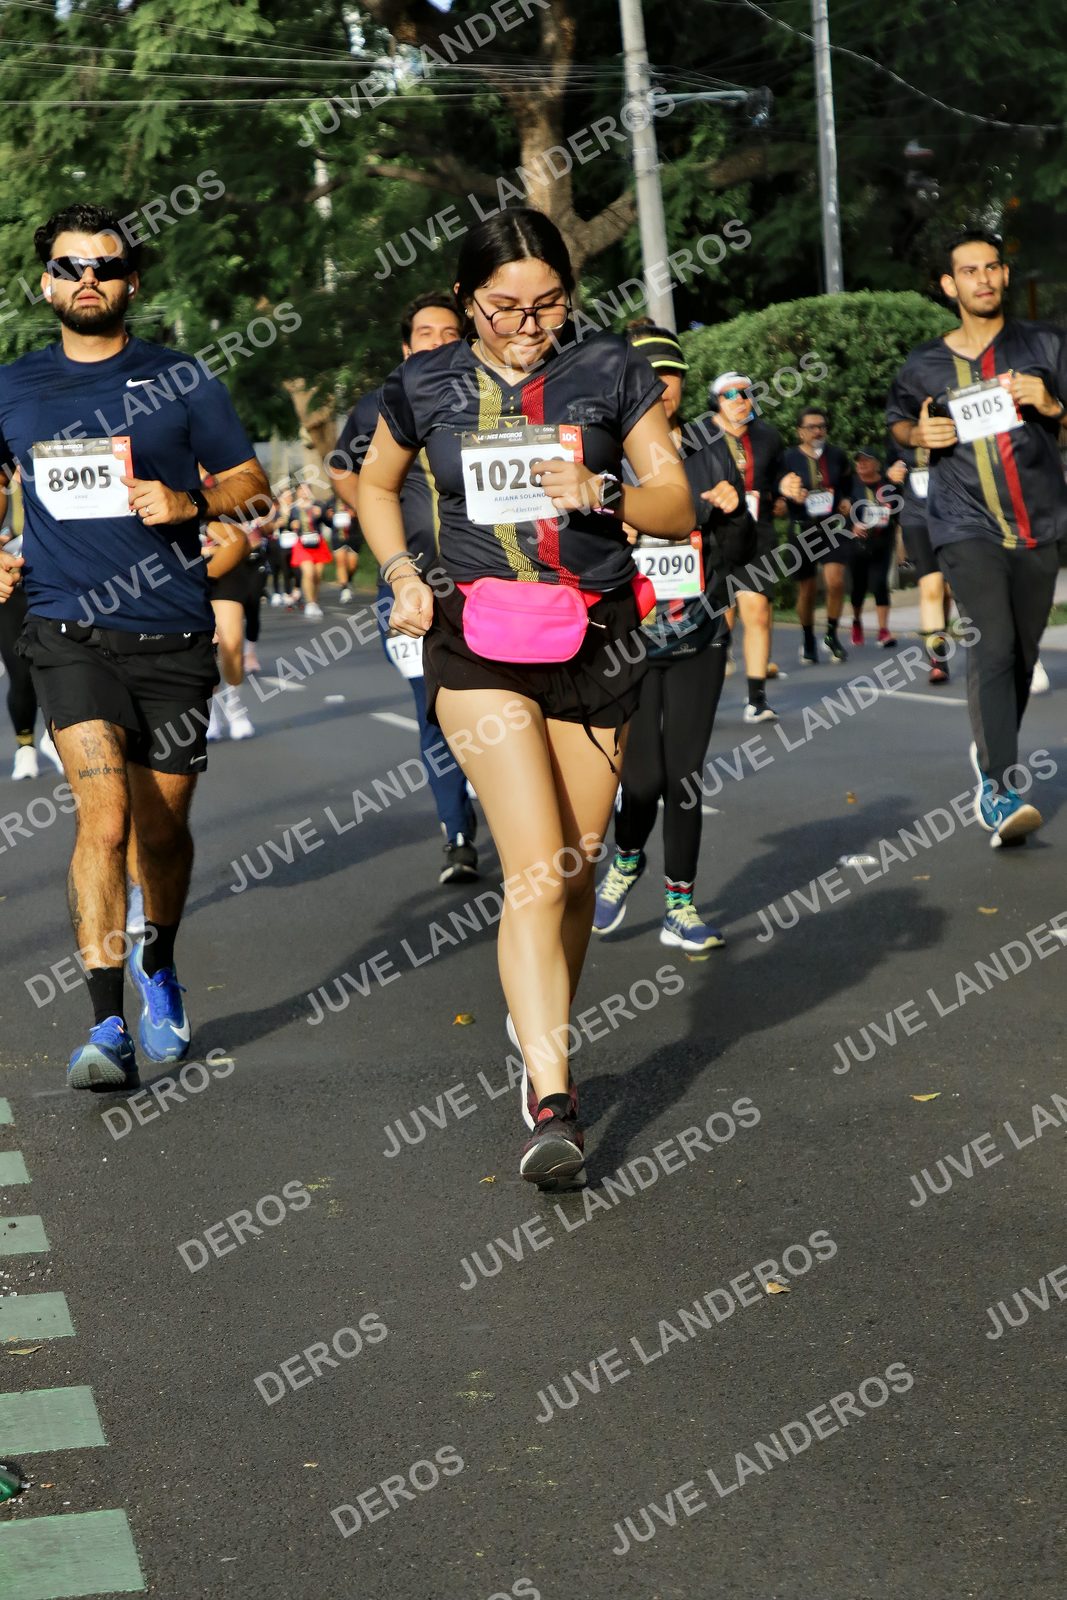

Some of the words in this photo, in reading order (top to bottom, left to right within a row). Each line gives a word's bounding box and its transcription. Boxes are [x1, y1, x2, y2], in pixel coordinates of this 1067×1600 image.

[961, 395, 1003, 421] 8105
[48, 465, 111, 492] 8905
[469, 456, 565, 491] 1028
